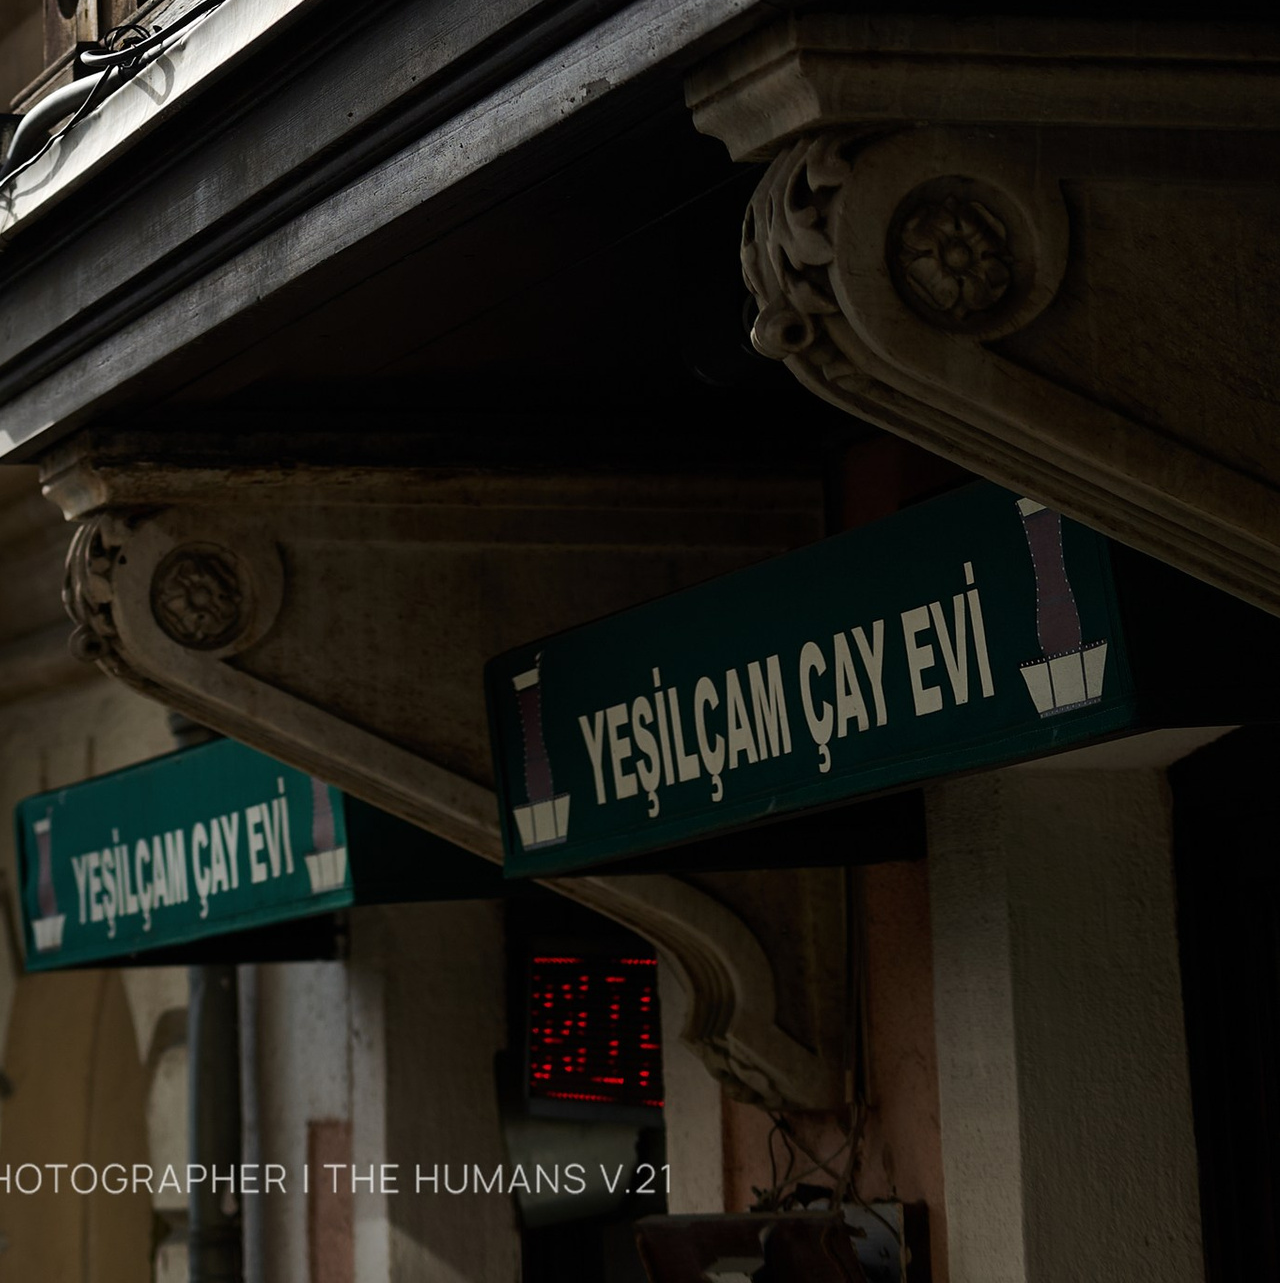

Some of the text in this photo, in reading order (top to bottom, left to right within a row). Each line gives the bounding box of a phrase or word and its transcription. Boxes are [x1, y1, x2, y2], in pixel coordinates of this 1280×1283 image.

[578, 561, 996, 818] YEŞİLÇAM ÇAY EVİ
[71, 776, 295, 938] YEŞİLÇAM ÇAY EVİ
